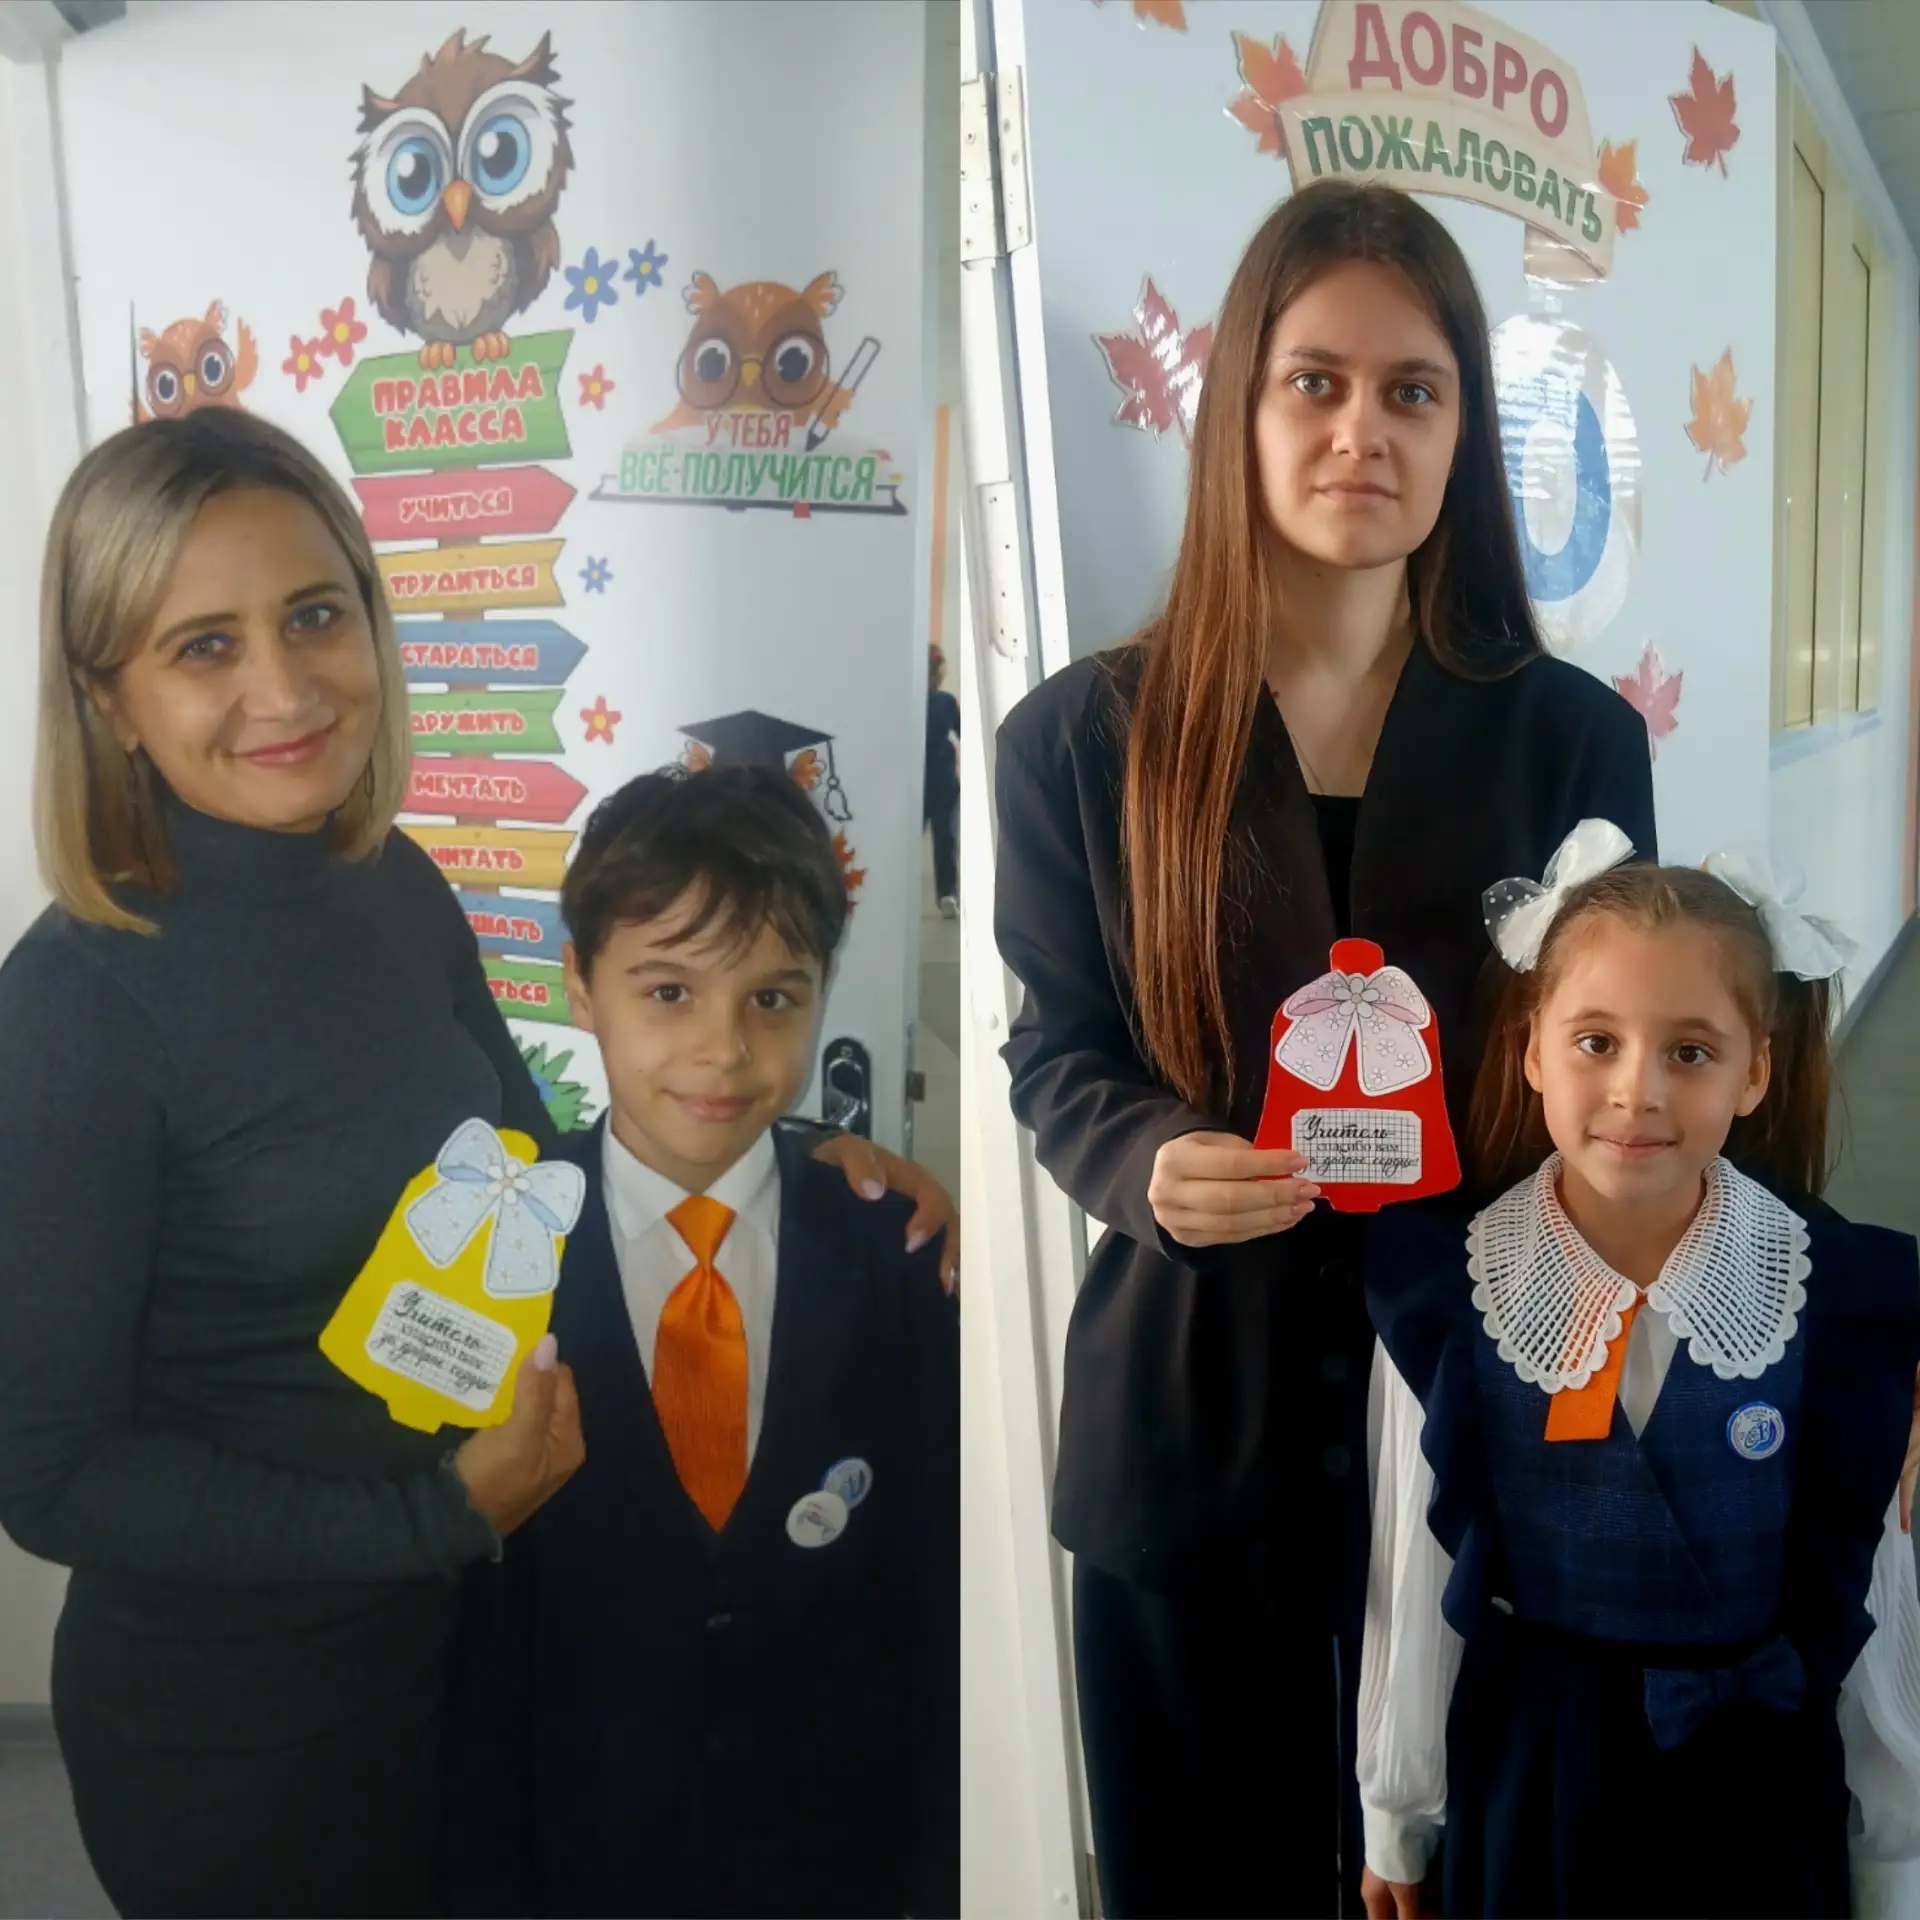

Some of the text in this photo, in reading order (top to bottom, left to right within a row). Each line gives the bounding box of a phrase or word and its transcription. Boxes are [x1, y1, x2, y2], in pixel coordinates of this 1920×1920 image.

[1347, 3, 1569, 138] ДОБРО
[1302, 113, 1603, 243] ПОЖАЛОВАТЬ
[372, 365, 543, 415] ПРАВИЛА
[383, 407, 527, 452] КЛАССА
[704, 411, 792, 449] У ТЕБЯ
[681, 451, 878, 501] ПОЛУЧИТСЯ
[400, 488, 513, 523] УЧИТЬСЯ
[389, 564, 538, 598] ТРУДИТЬСЯ
[401, 644, 540, 670] СТАРАТЬСЯ
[410, 708, 527, 735] ДРУЖИТЬ
[412, 772, 527, 804] МЕЧТАТЬ
[464, 911, 544, 943] ШАТЬ
[486, 977, 550, 1007] ТЬСЯ
